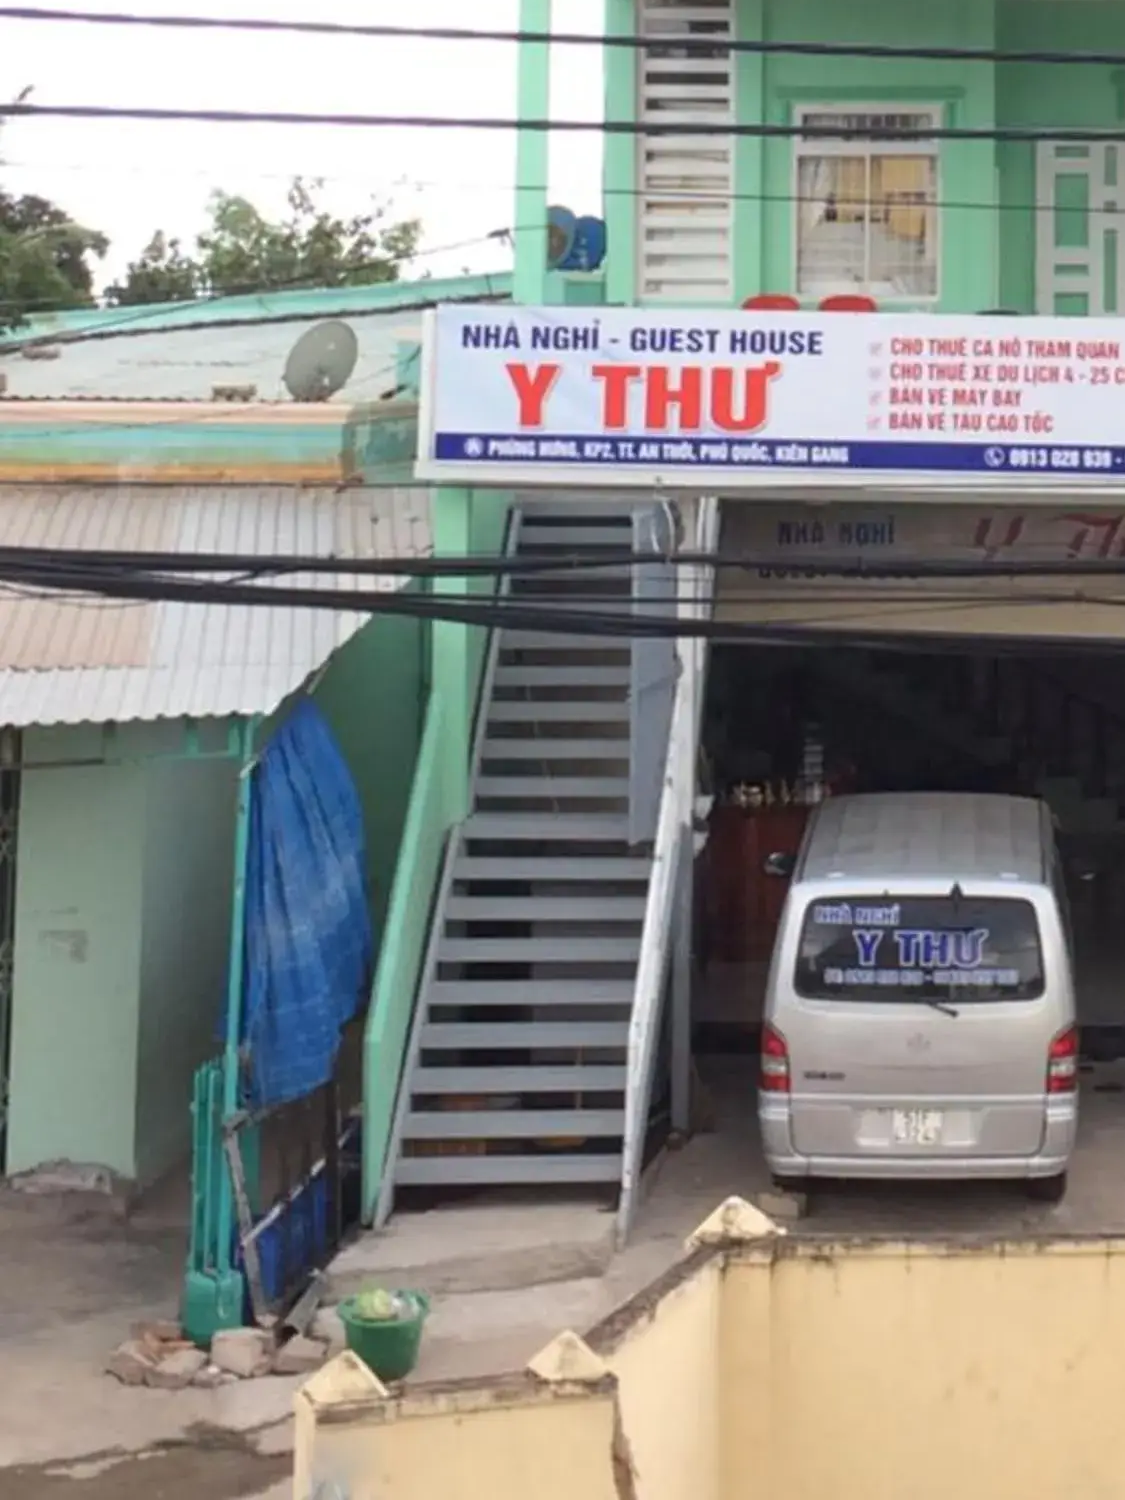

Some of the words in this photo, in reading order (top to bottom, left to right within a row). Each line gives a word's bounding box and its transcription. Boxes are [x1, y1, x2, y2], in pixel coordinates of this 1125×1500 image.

[462, 317, 521, 349] NHÀ
[531, 318, 600, 351] NGHỈ
[630, 327, 720, 354] GUEST
[730, 328, 824, 356] HOUSE
[891, 338, 923, 355] CHO
[972, 339, 993, 357] CA
[1026, 340, 1072, 358] THAM
[1076, 341, 1120, 361] QUAN
[890, 363, 923, 380] CHO
[972, 364, 992, 382] XE
[998, 365, 1019, 382] DU
[1064, 367, 1074, 382] 4
[1090, 367, 1110, 384] 25
[504, 362, 559, 428] Y
[591, 361, 782, 433] THƯ
[992, 389, 1022, 406] BAY
[986, 413, 1019, 431] CAO
[852, 929, 884, 967] Y
[893, 928, 990, 968] THƯ
